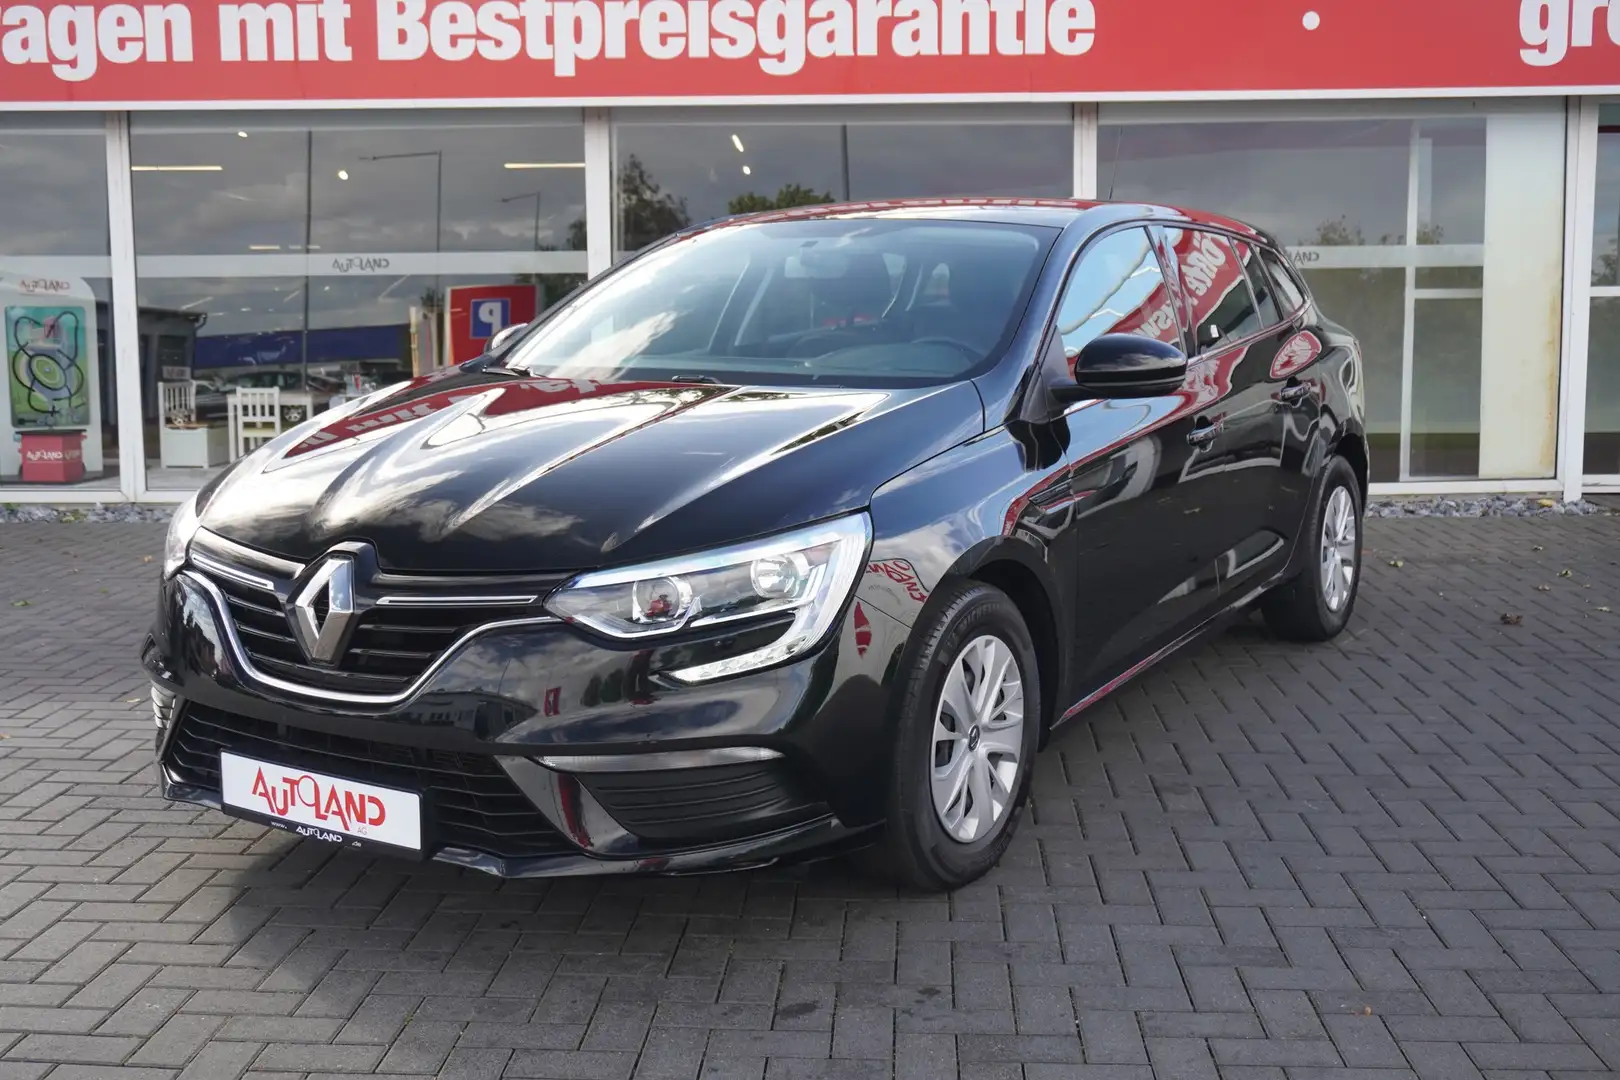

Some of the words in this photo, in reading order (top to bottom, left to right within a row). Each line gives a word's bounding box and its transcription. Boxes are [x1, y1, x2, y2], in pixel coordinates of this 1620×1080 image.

[218, 0, 353, 62] mit
[377, 0, 1096, 77] Bestpreisgarantie
[331, 256, 390, 273] AUTOLAND
[251, 766, 386, 831] AUTOLAND
[296, 826, 343, 842] AUTOLAND
[356, 826, 368, 836] AG
